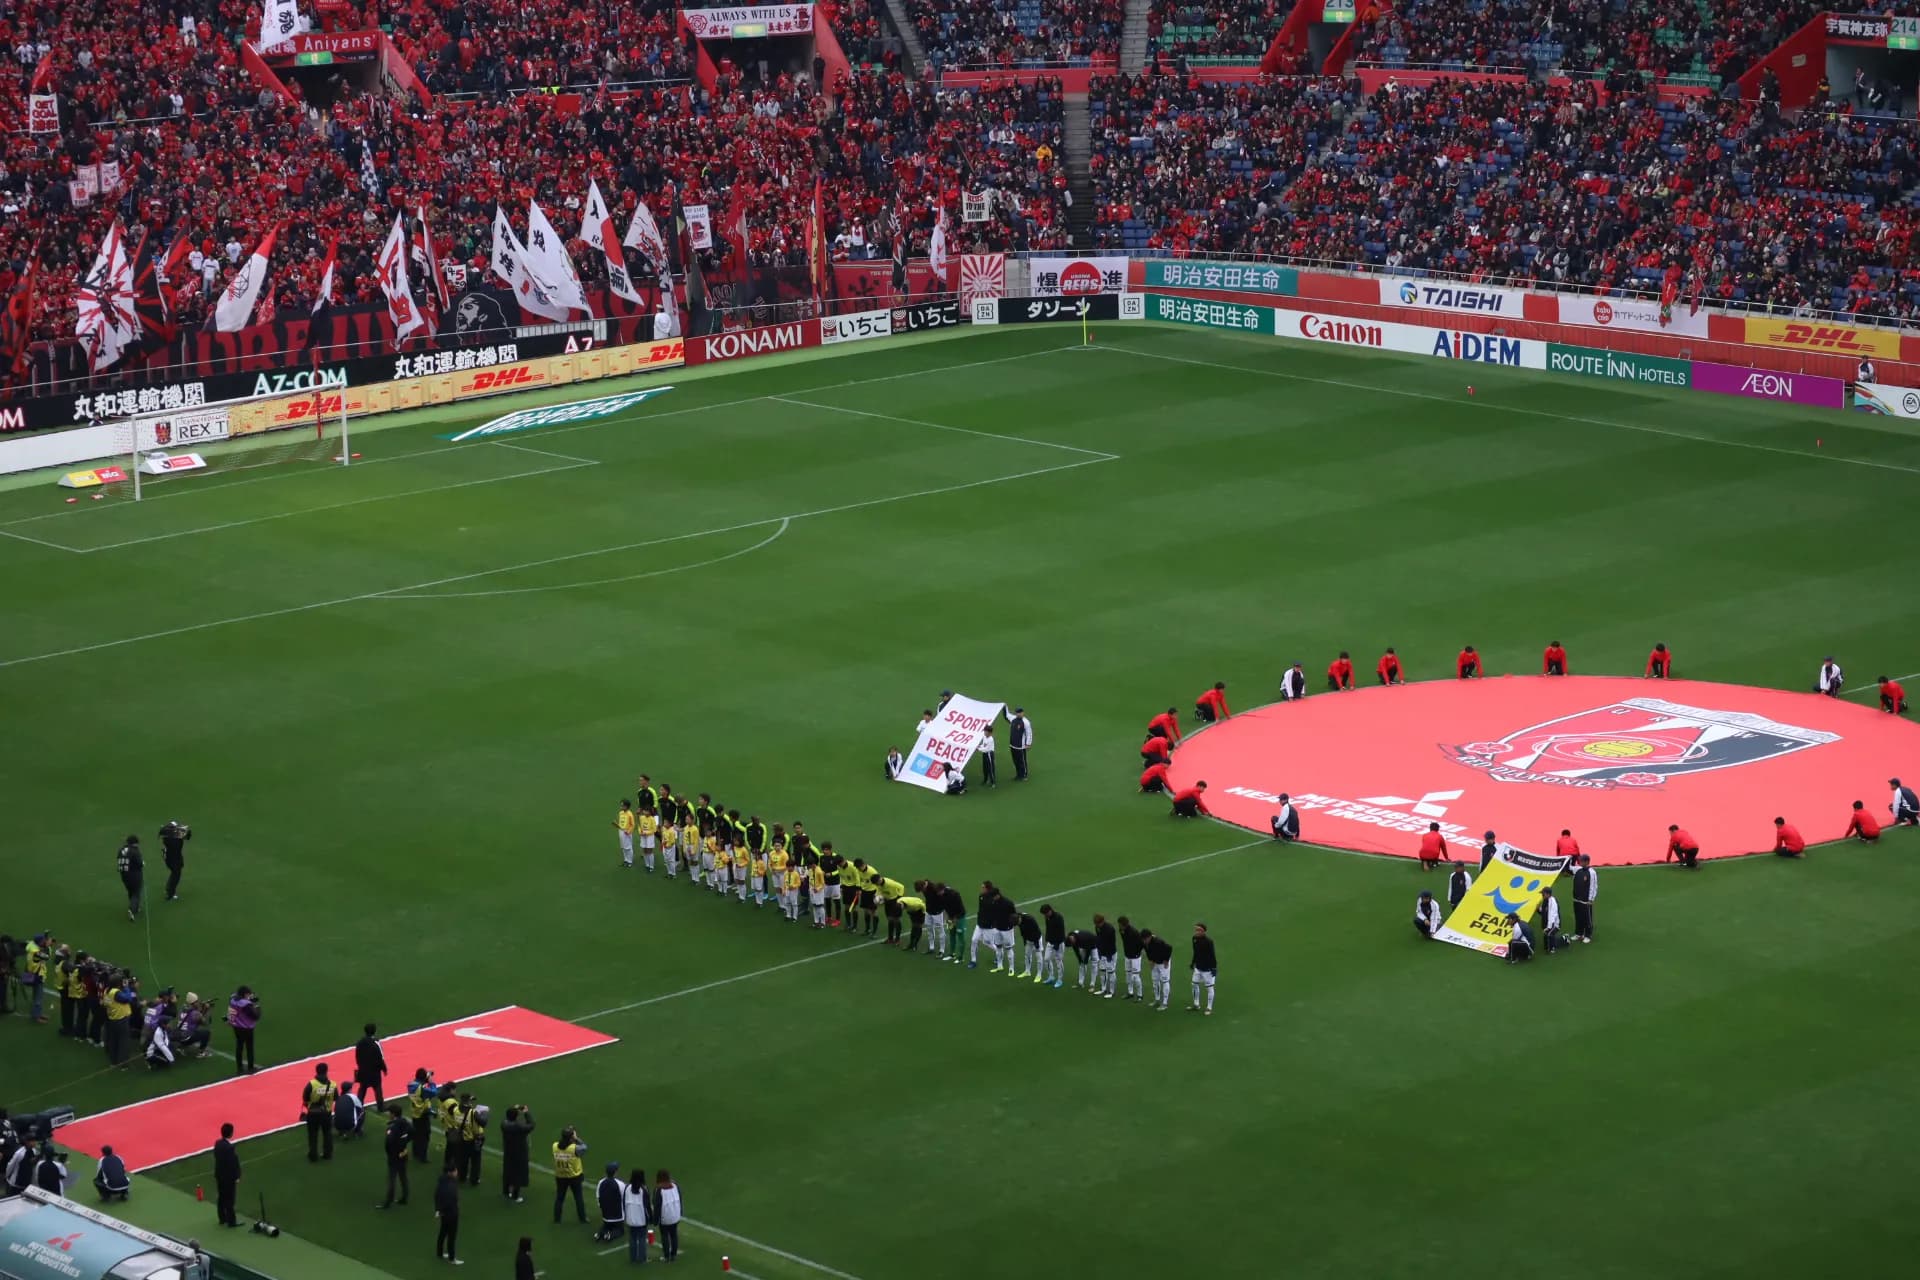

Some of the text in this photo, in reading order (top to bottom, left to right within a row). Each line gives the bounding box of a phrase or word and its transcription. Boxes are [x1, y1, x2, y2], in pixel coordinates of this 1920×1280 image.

[709, 8, 791, 22] ALWAYS WITH US
[1892, 20, 1917, 34] 214
[304, 35, 376, 51] Aniyans'
[1037, 272, 1058, 293] 爆
[1063, 279, 1099, 291] REDS
[1102, 270, 1122, 291] 進
[1163, 265, 1280, 290] 明治安田生命
[1423, 287, 1503, 312] TAISHI
[839, 312, 889, 338] いちご
[908, 302, 957, 329] いちご
[1159, 298, 1259, 330] 明治安田生命
[705, 324, 802, 360] KONAMI
[1300, 314, 1382, 347] Canon
[1783, 324, 1862, 350] DHL
[394, 343, 519, 380] 丸和運輸機関
[1551, 352, 1603, 376] ROUTE
[1639, 368, 1687, 386] HOTELS
[471, 366, 535, 390] DHL
[73, 382, 205, 420] 丸和運輸機関
[286, 395, 346, 420] DHL
[179, 422, 211, 439] REX
[945, 730, 974, 745] FOR
[926, 738, 969, 763] PEACE!
[1296, 793, 1468, 832] MITSUBISHI
[1469, 920, 1513, 938] PLAY
